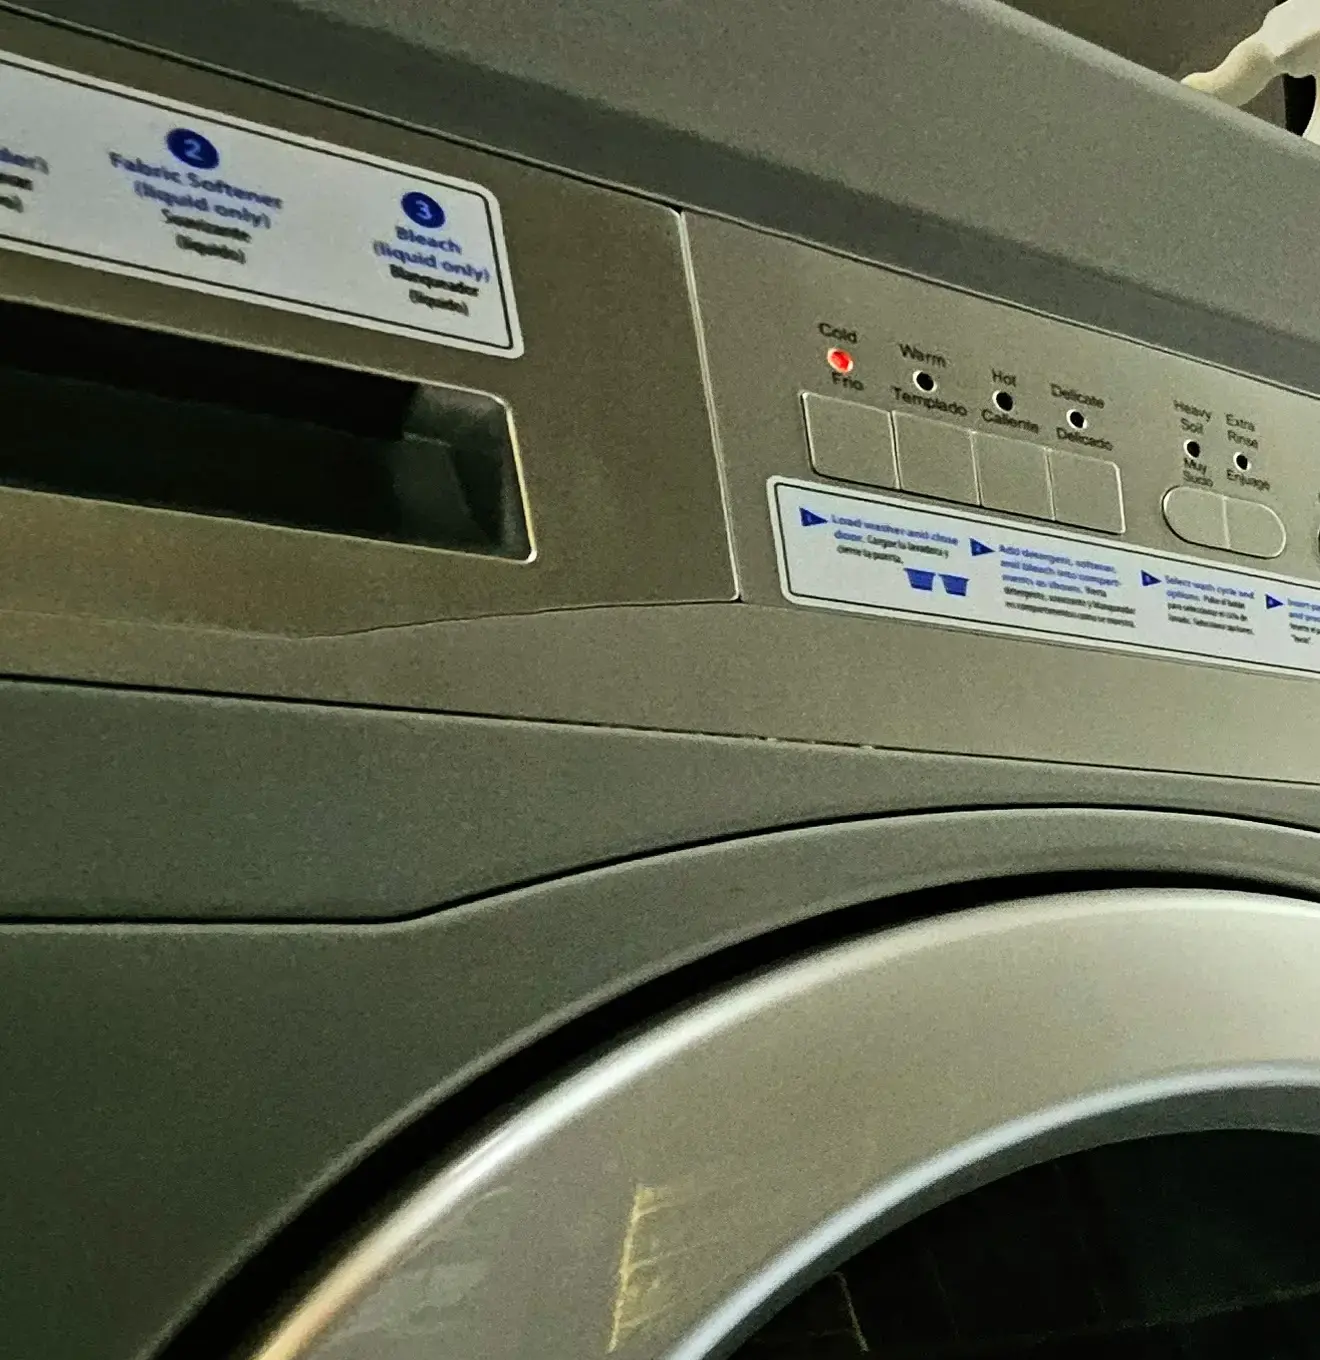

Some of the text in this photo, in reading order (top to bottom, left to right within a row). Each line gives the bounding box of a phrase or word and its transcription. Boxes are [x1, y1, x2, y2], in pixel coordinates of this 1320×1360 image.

[108, 151, 283, 209] Fabric Softener
[133, 180, 271, 229] (liquid only)
[395, 225, 463, 254] Bleach
[373, 240, 490, 283] (liquid only)
[818, 322, 858, 343] Cold
[899, 343, 948, 368] Warm
[991, 368, 1017, 387] Hot
[891, 385, 968, 417] Templado
[1050, 383, 1105, 409] Delicate
[980, 408, 1040, 434] Caliente
[1173, 399, 1213, 423] Heavy
[1225, 413, 1256, 433] Extra
[1180, 417, 1204, 435] Soil
[1056, 427, 1114, 451] Delicado
[1227, 429, 1259, 449] Rinse
[1183, 457, 1208, 476] Muy
[831, 514, 862, 528] Load
